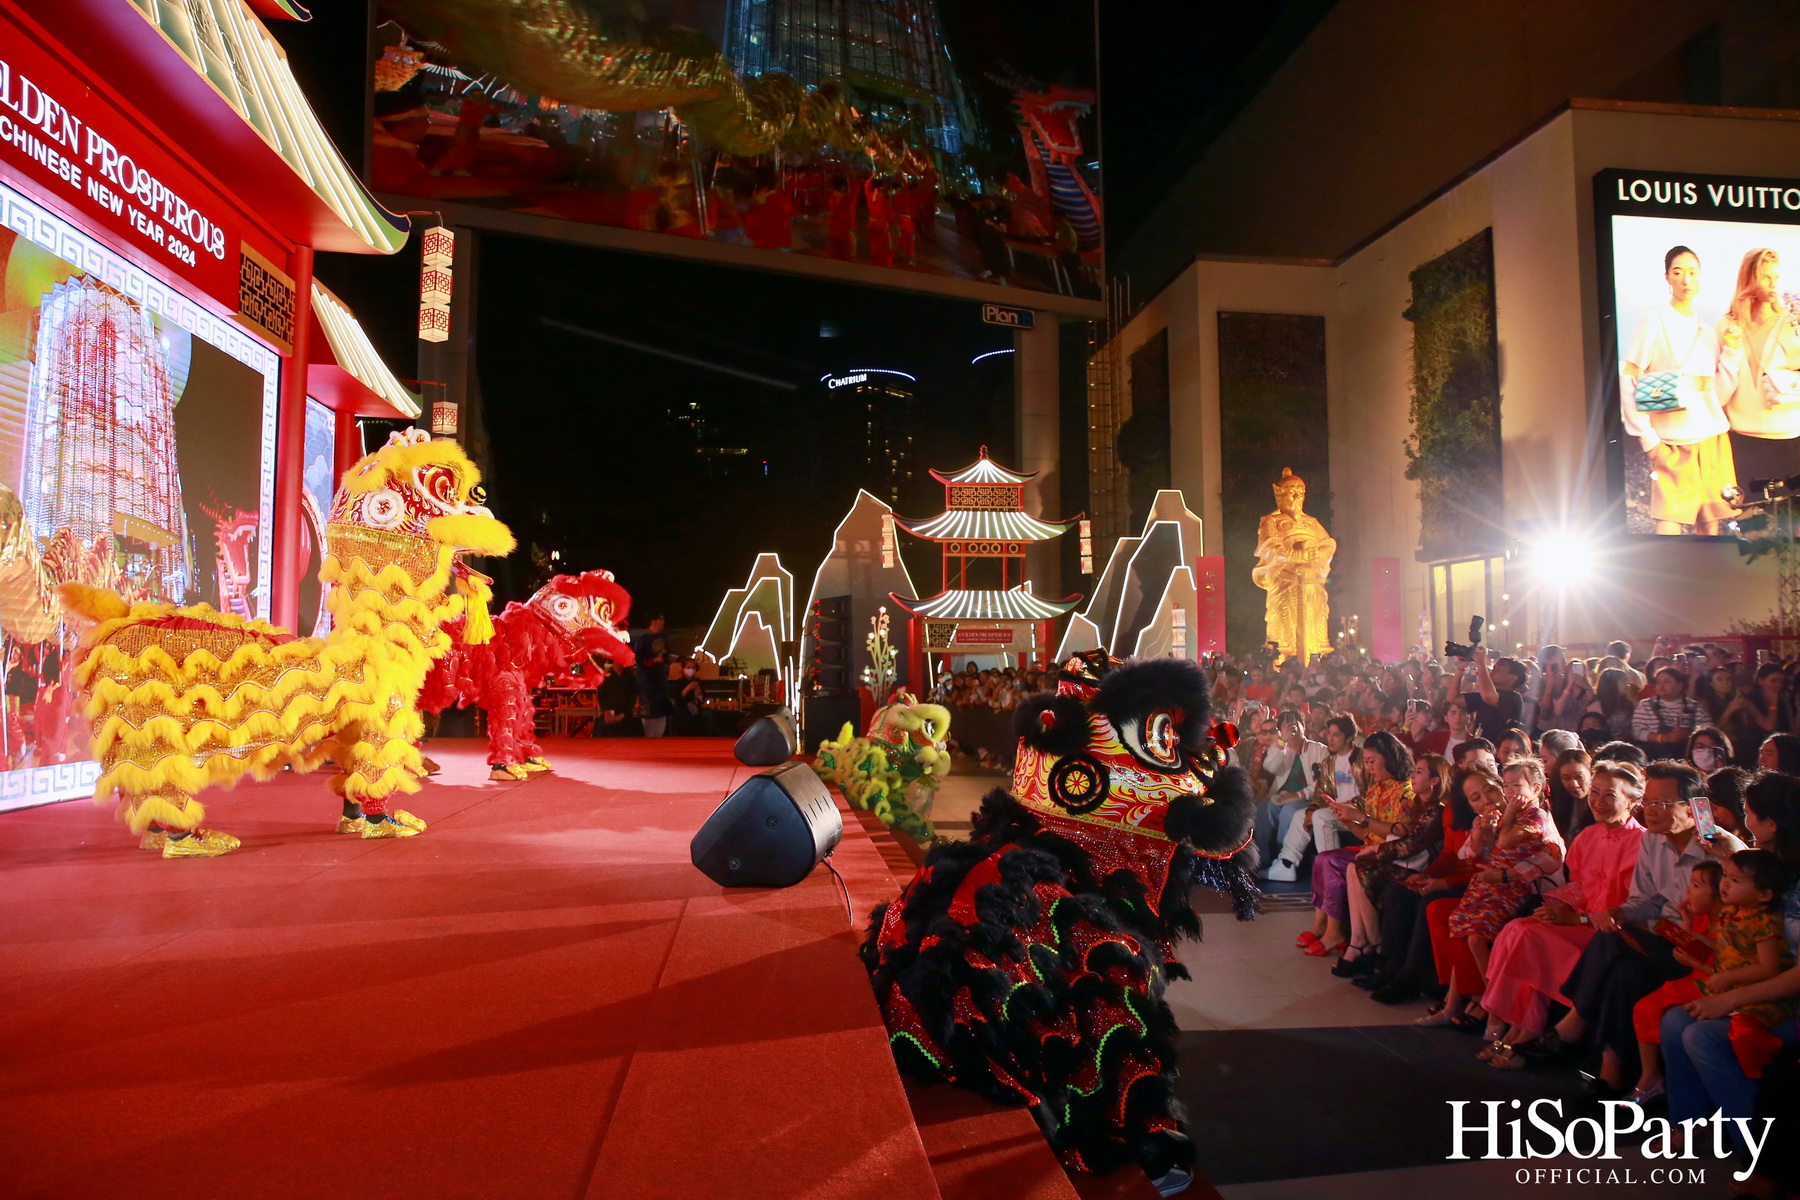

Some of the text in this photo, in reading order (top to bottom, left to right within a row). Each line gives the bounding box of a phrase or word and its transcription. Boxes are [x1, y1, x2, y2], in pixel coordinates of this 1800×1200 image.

[0, 60, 226, 260] LDEN PROSPEROUS
[0, 115, 196, 268] CHINESE NEW YEAR 2024
[1617, 178, 1698, 205] LOUIS
[986, 306, 1018, 325] Plan
[828, 373, 867, 389] CHATRIUM
